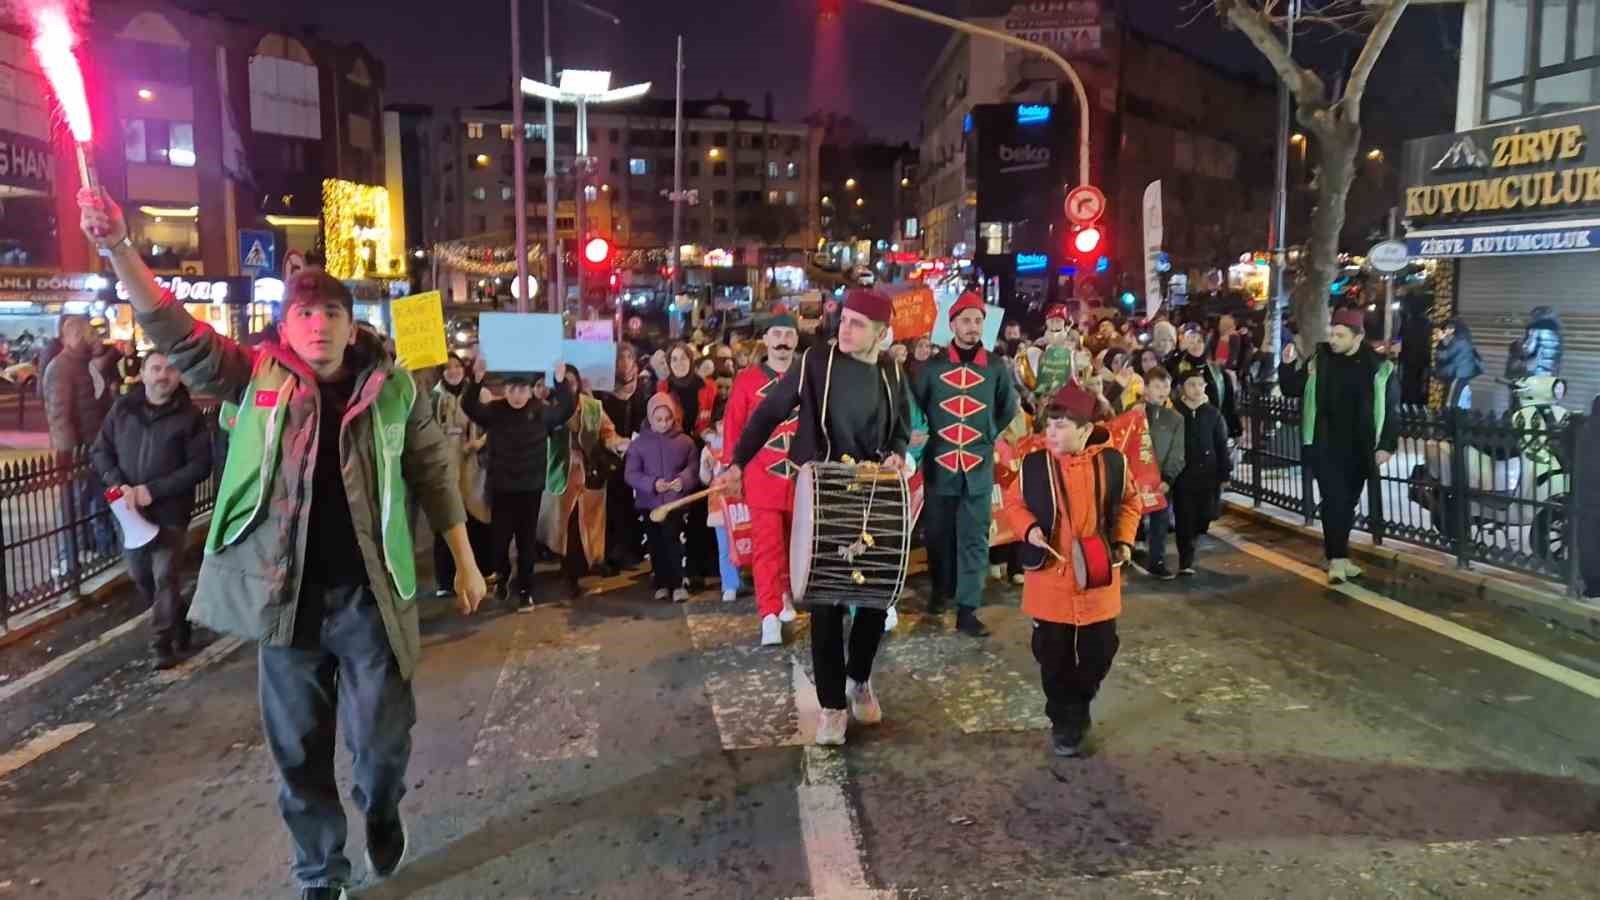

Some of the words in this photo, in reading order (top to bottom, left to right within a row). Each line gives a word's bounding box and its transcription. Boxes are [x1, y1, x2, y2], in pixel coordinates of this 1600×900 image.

[1000, 144, 1050, 161] beko
[1492, 127, 1583, 167] ZİRVE
[1406, 166, 1600, 216] KUYUMCULUK
[1472, 231, 1591, 253] KUYUMCULUK
